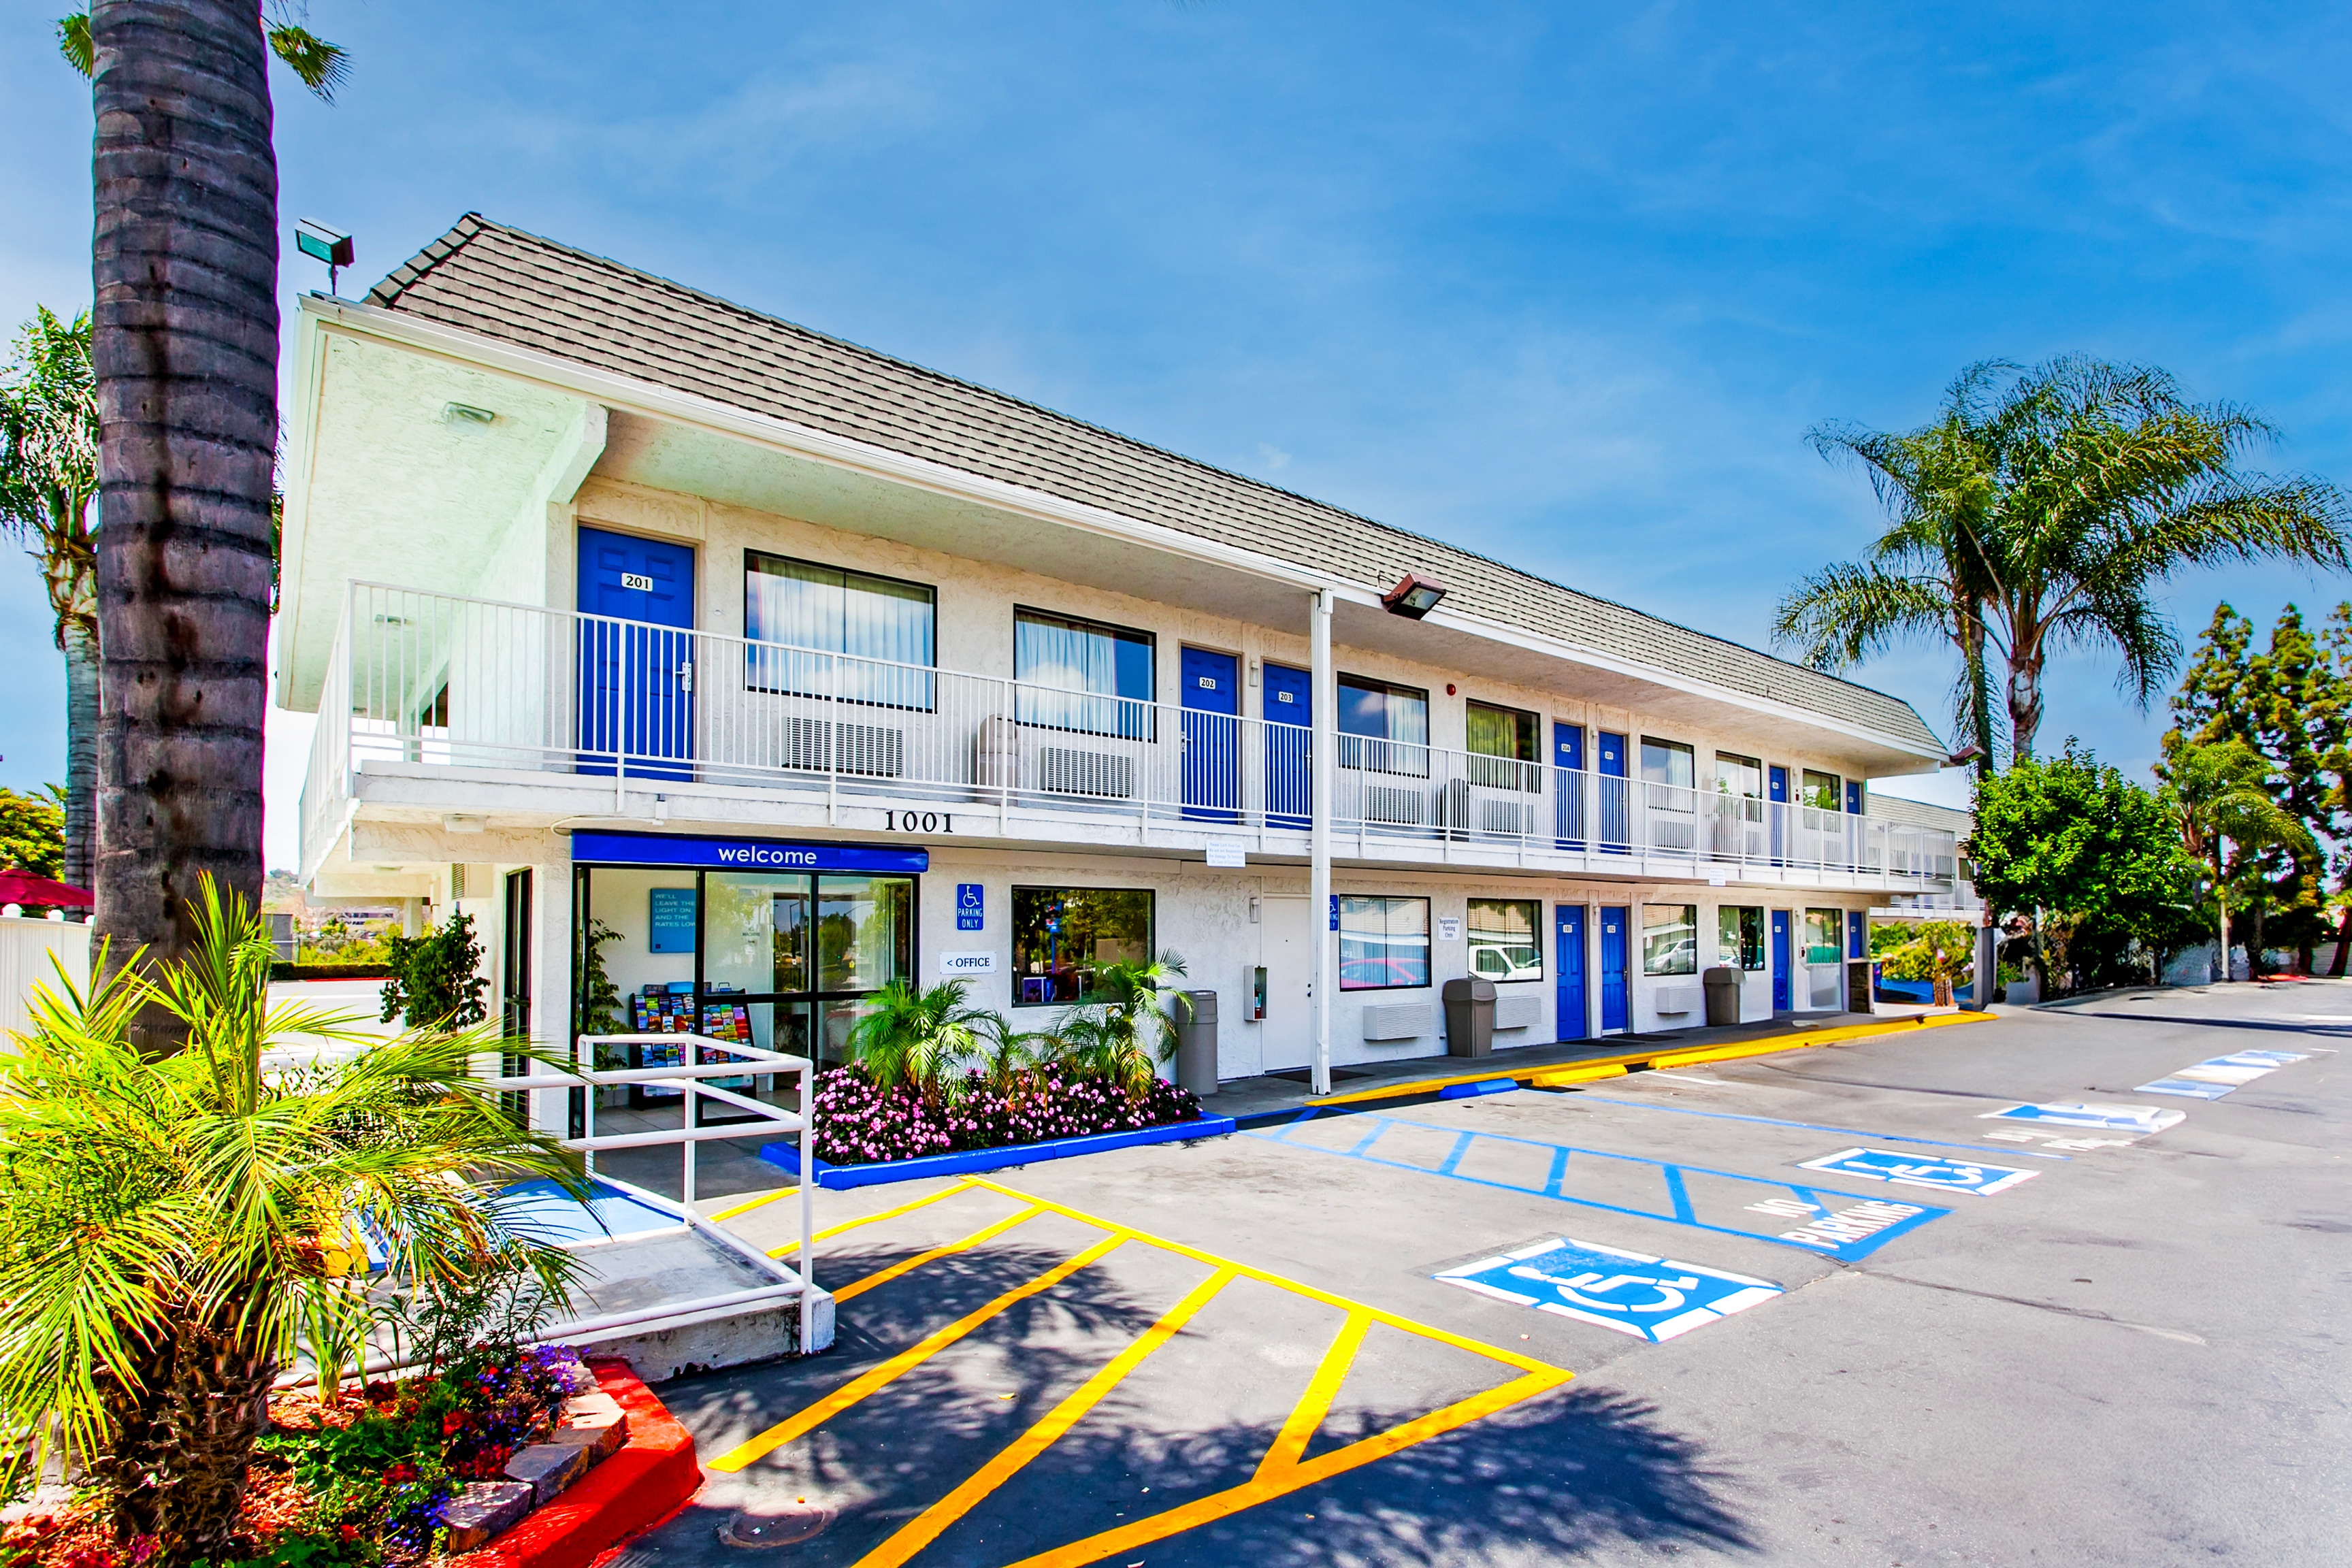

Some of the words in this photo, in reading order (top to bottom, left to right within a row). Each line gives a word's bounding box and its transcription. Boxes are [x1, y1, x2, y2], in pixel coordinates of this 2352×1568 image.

[626, 575, 649, 589] 201
[1201, 679, 1214, 688] 202
[1280, 693, 1292, 702] 203
[885, 811, 953, 833] 1001
[718, 845, 817, 865] welcome
[958, 908, 983, 917] PARKING
[962, 919, 978, 928] ONLY
[956, 958, 990, 967] OFFICE
[1743, 1198, 1821, 1218] NO
[1778, 1200, 1925, 1250] PARKING
